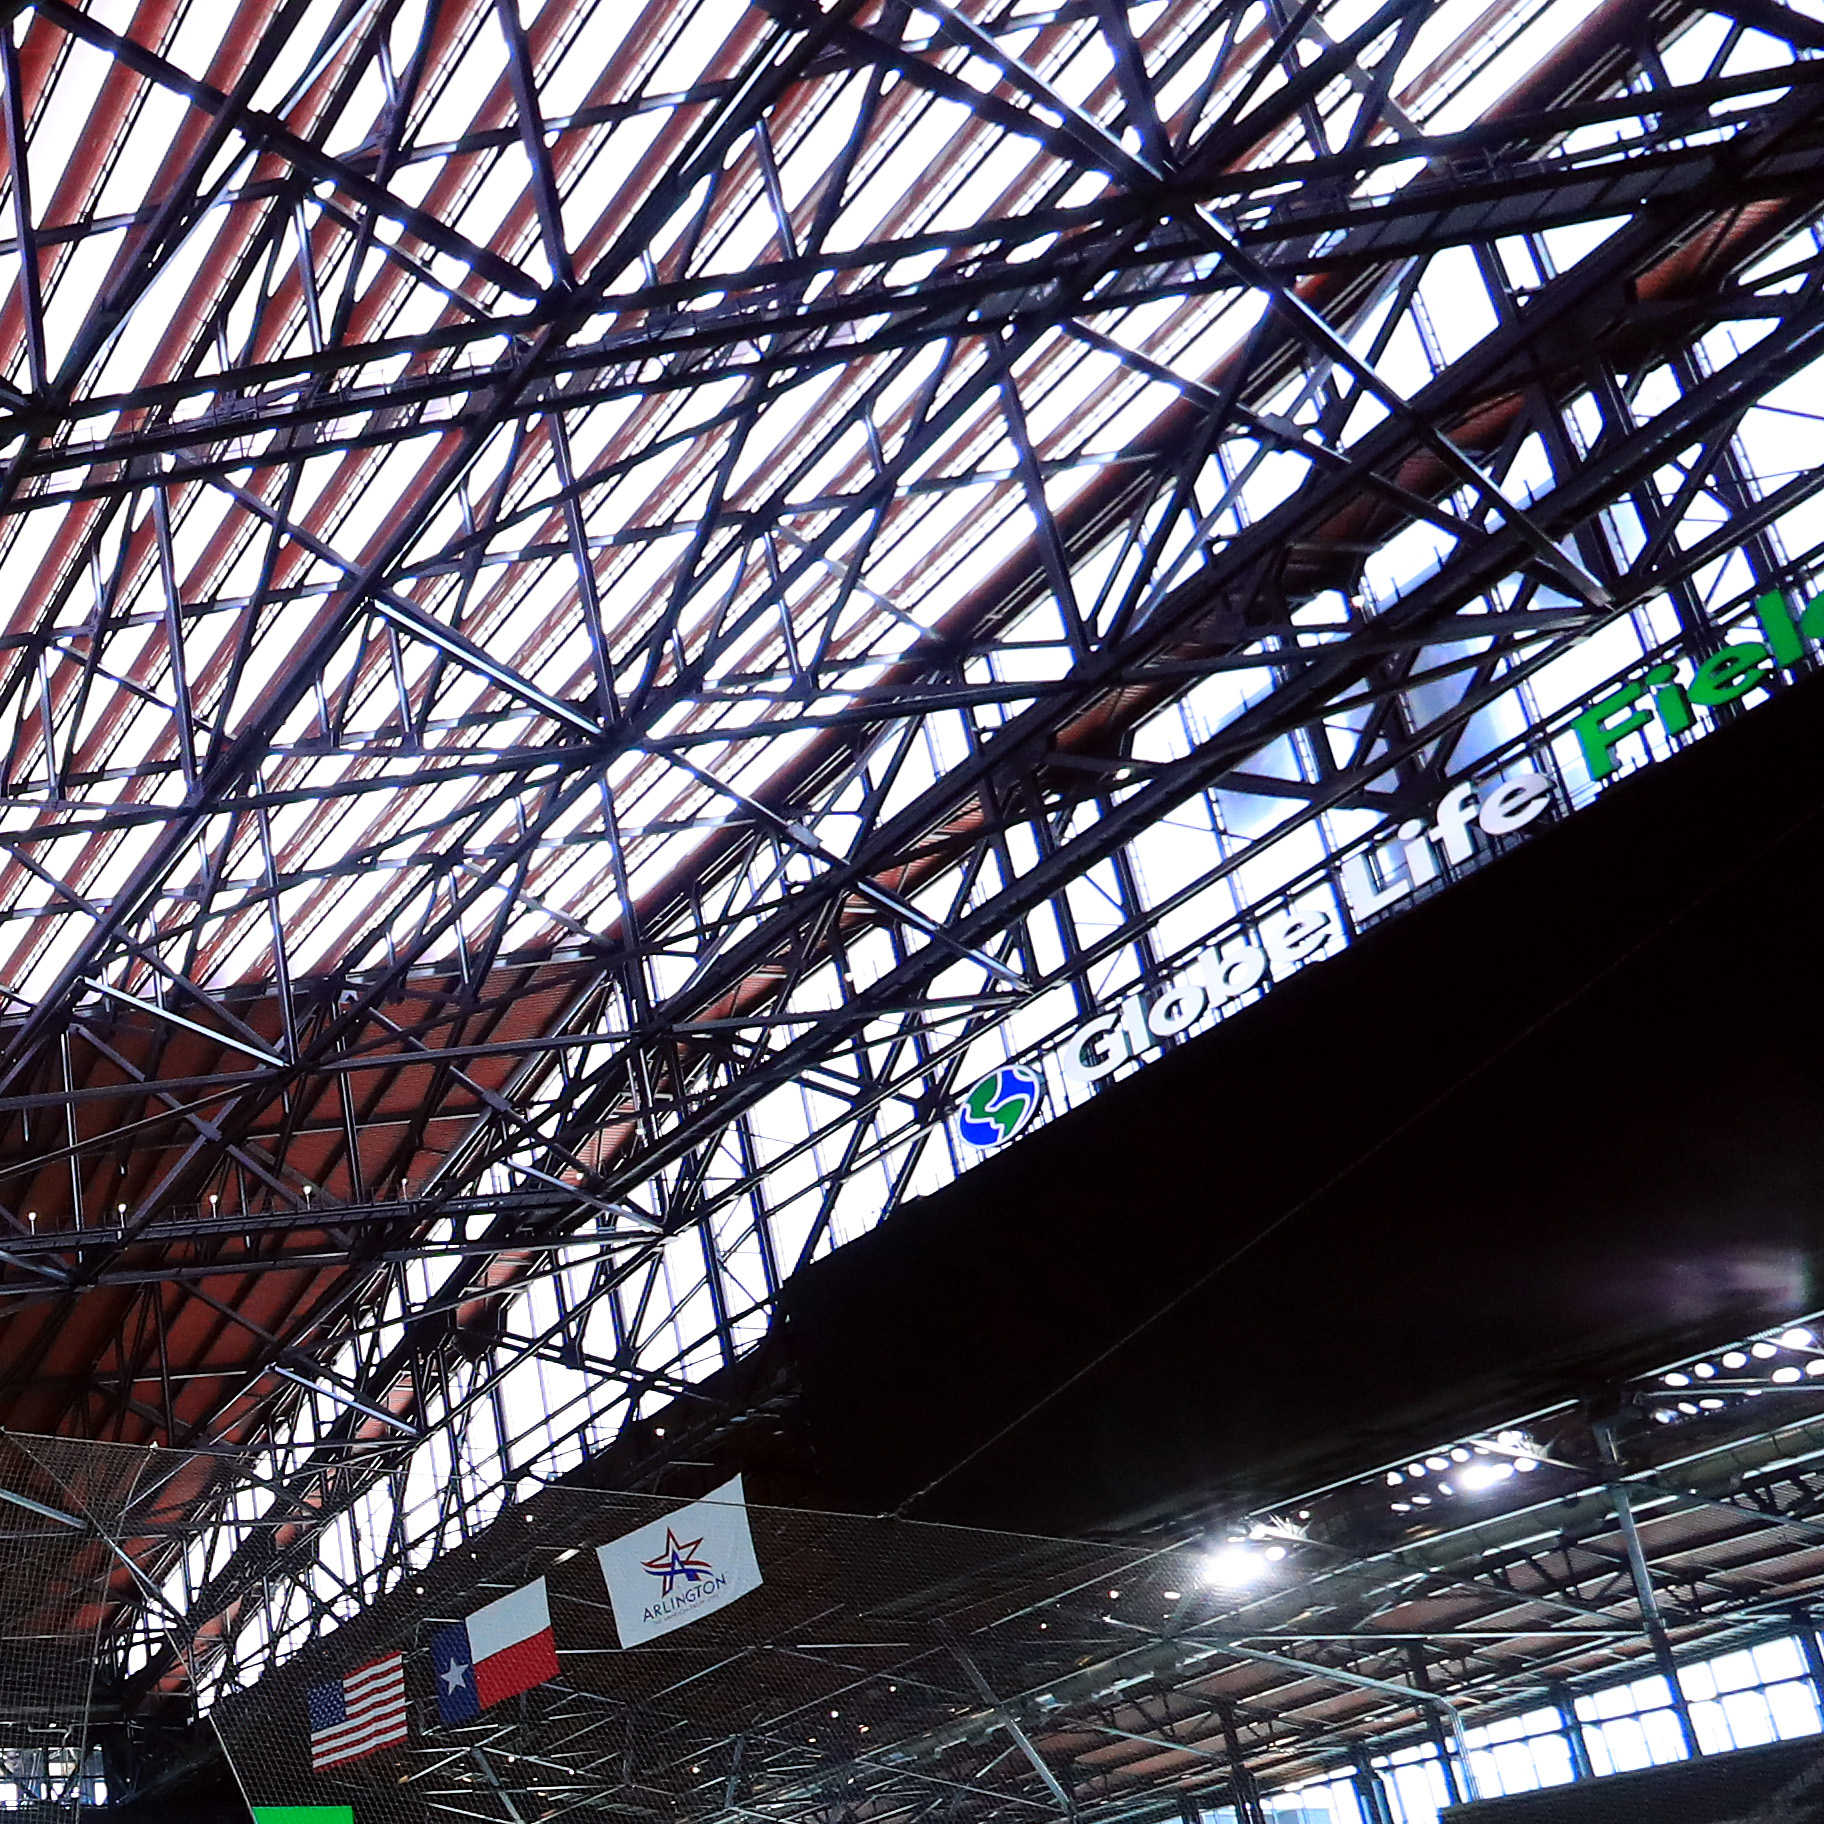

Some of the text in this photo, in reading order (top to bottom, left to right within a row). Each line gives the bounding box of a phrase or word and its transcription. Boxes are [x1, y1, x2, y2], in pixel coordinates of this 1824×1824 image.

[1063, 589, 1824, 1085] Globe Life Fiel
[643, 1573, 727, 1623] ARLINGTON
